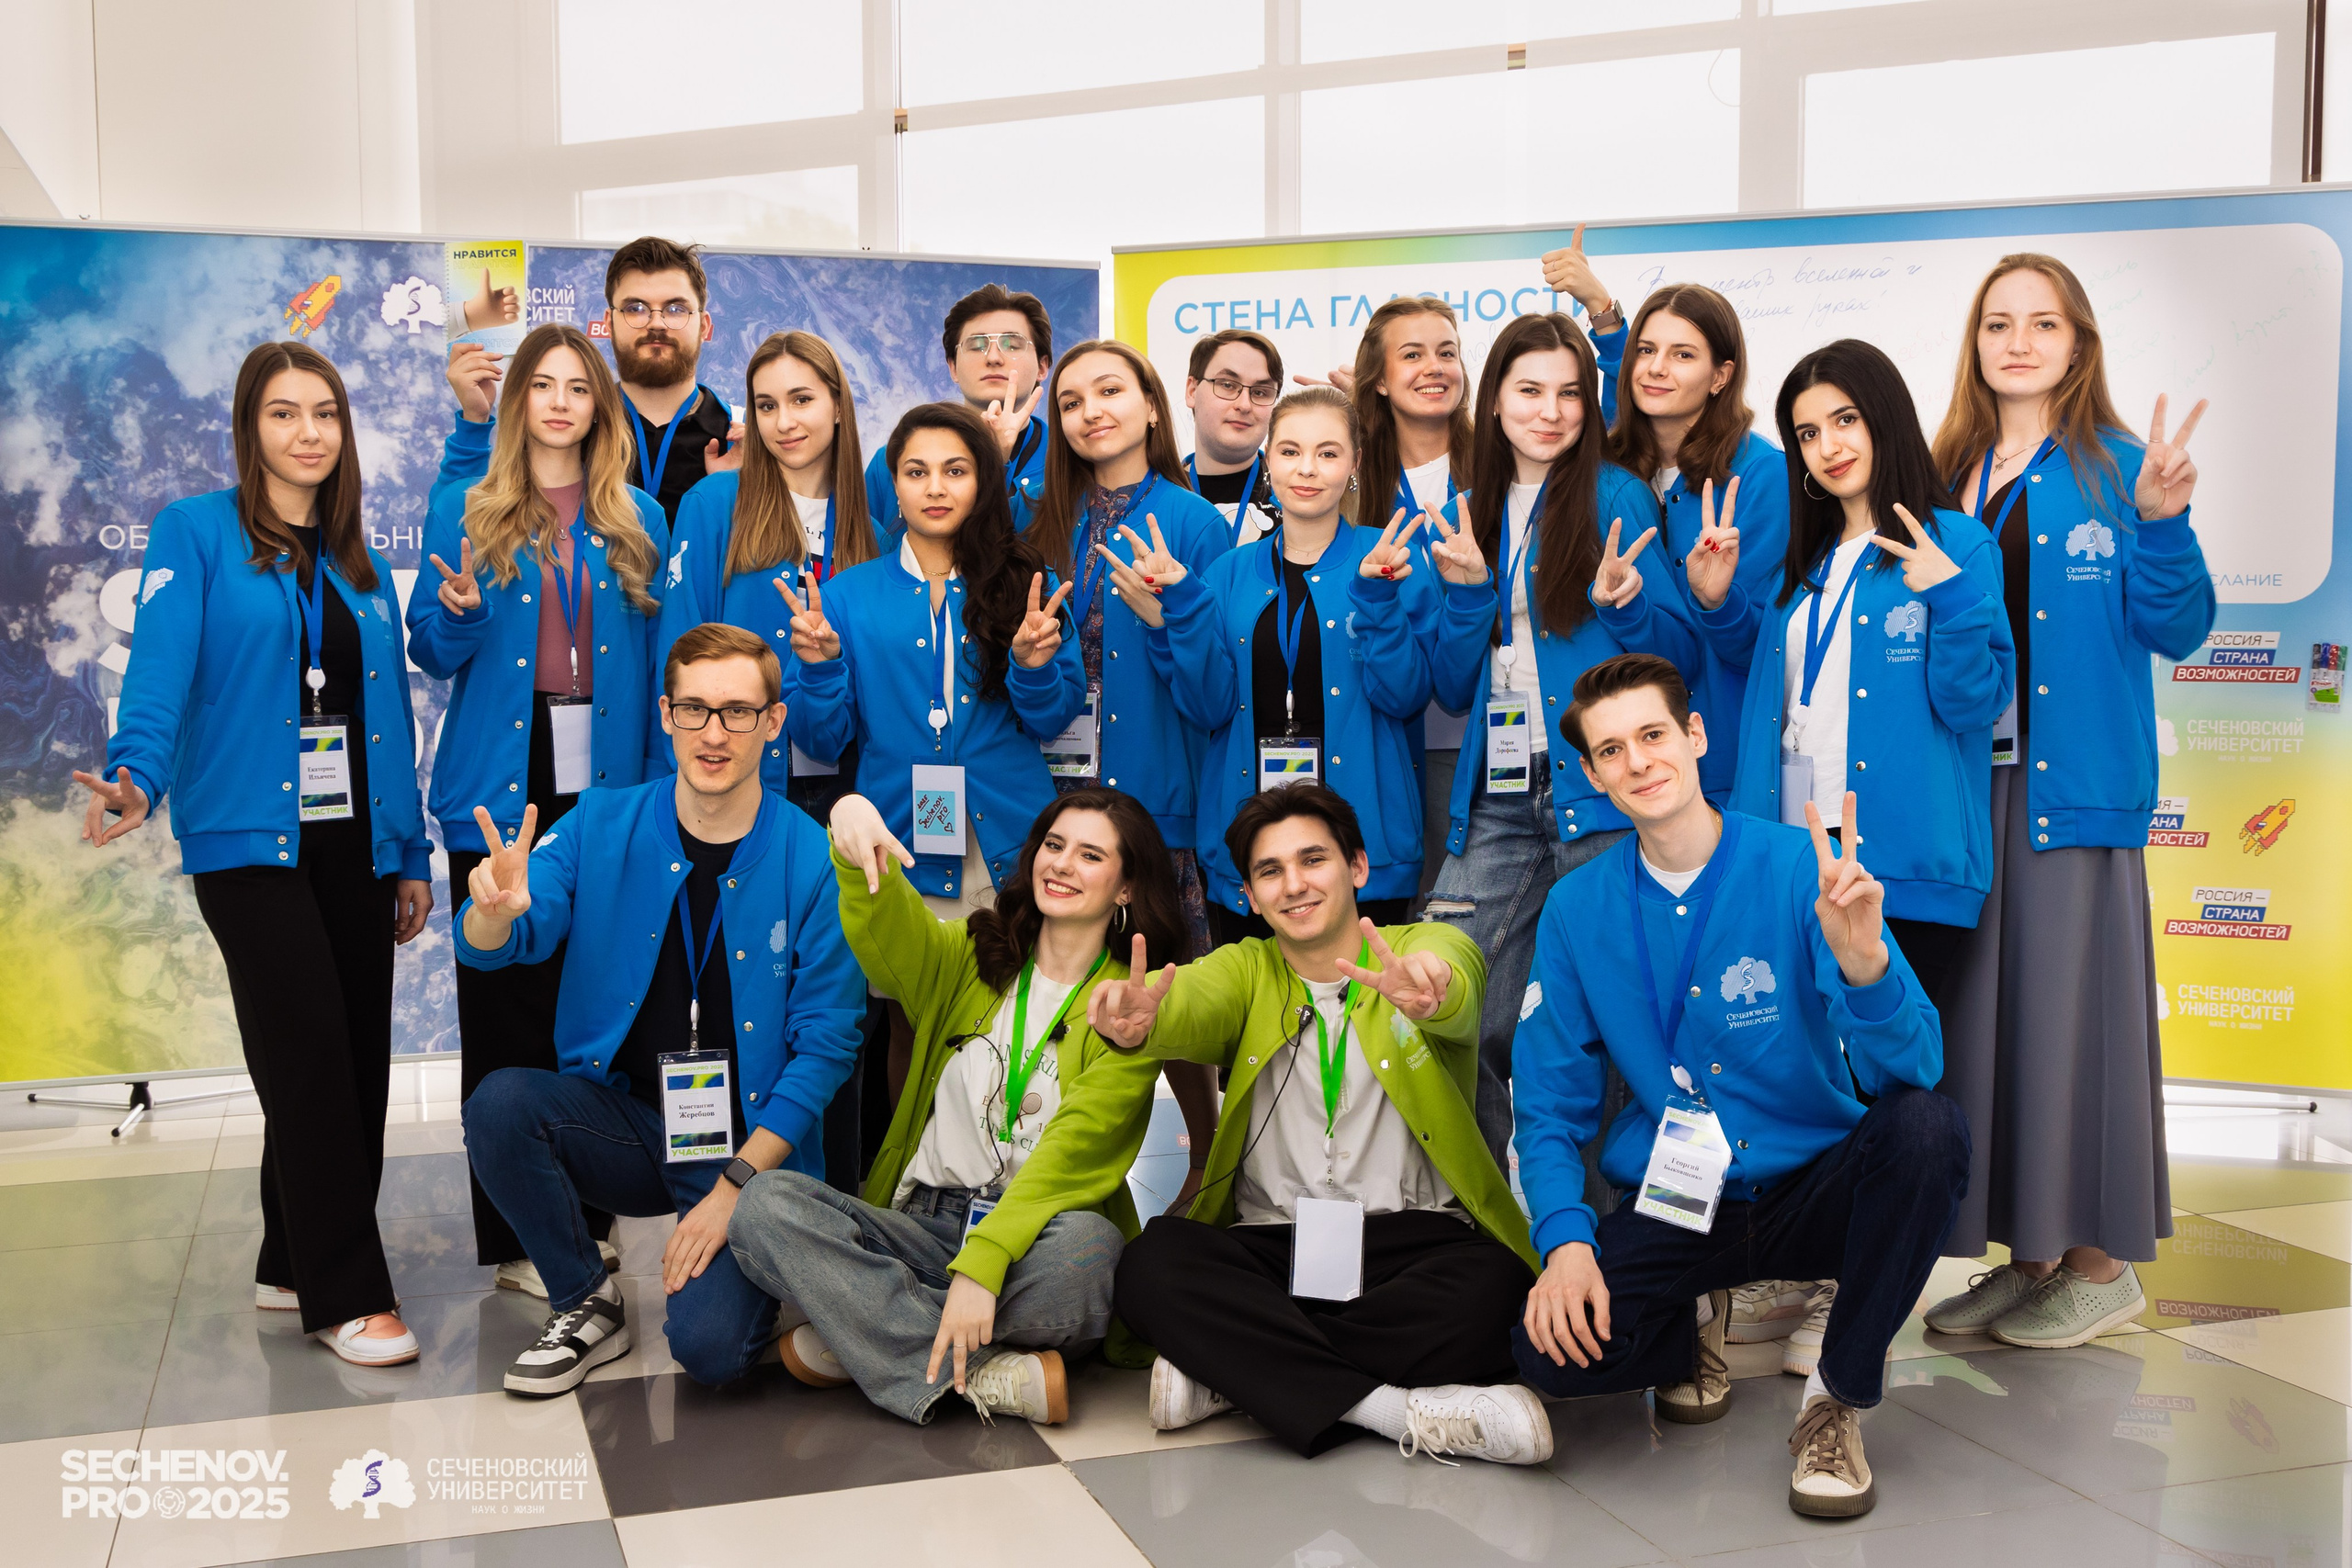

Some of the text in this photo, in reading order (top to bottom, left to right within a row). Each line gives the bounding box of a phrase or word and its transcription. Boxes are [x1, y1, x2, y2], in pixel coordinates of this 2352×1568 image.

[453, 249, 517, 259] НРАВИТСЯ
[1792, 257, 1894, 283] вселенной
[1174, 288, 1586, 333] СТЕНА ГЛНОСТ
[2211, 574, 2282, 586] СЛАНИЕ
[2205, 634, 2262, 646] РОССИЯ
[2213, 651, 2269, 664] СТРАНА
[2176, 668, 2297, 682] ВОЗМОЖНОСТЕЙ
[2187, 717, 2304, 736] СЕЧЕНОВСКИЙ
[2187, 737, 2304, 753] УНИВЕРСИТЕТ
[302, 807, 348, 816] УЧАСТНИК
[936, 806, 948, 824] pro
[2149, 817, 2178, 828] АНА
[2148, 832, 2205, 845] НОСТЕЙ
[2196, 889, 2253, 902] РОССИЯ
[2205, 907, 2260, 920] СТРАНА
[2167, 921, 2288, 939] ВОЗМОЖНОСТЕЙ
[2177, 984, 2295, 1005] СЕЧЕНОВСКИЙ
[2177, 1000, 2295, 1021] УНИВЕРСИТЕТ
[679, 1111, 715, 1120] Жеребцов
[671, 1145, 727, 1156] УЧАСТНИК
[1671, 1157, 1701, 1171] Георгий
[1643, 1200, 1704, 1225] УЧАСТНИК
